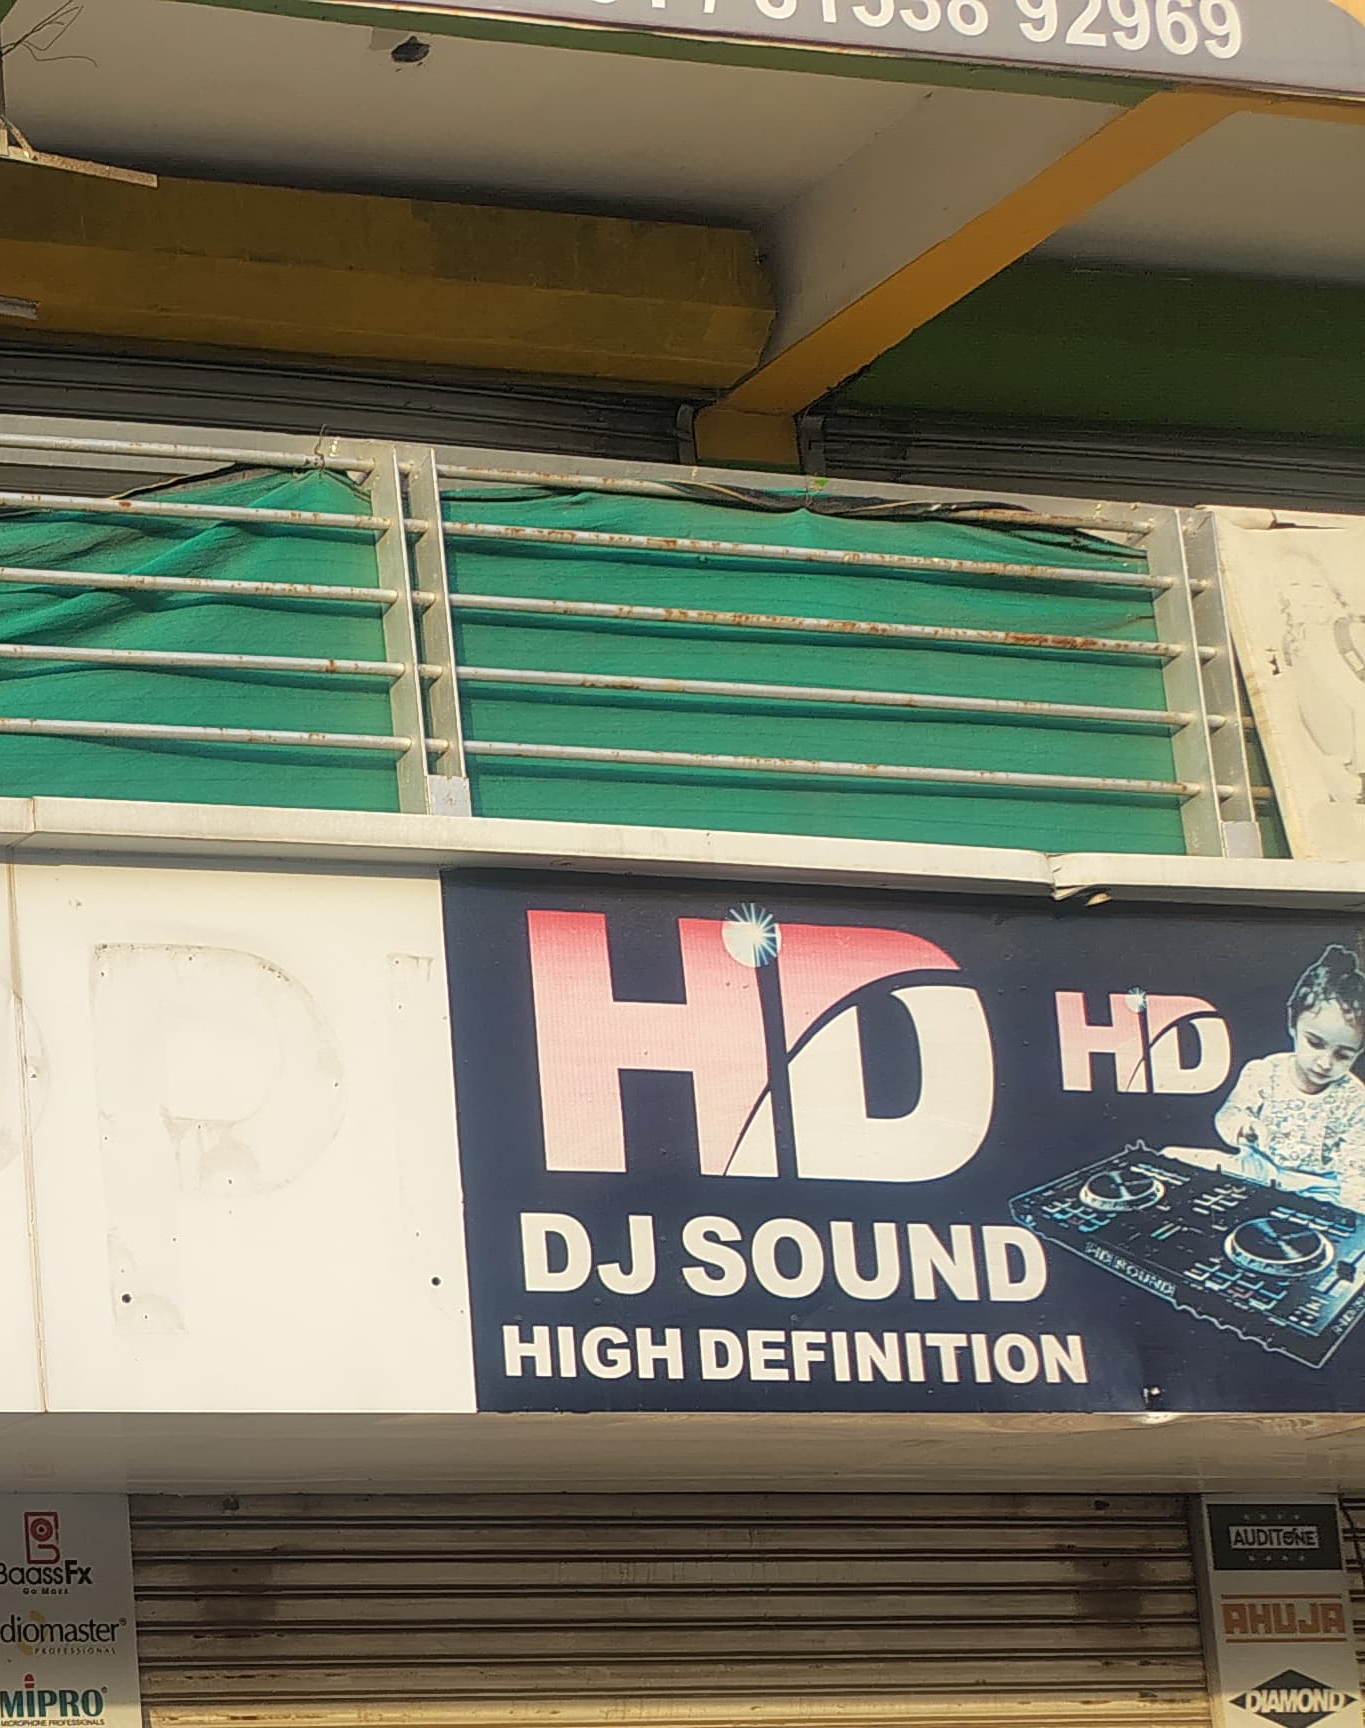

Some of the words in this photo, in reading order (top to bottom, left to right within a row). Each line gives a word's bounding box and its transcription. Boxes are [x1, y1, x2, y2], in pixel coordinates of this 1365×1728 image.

[527, 906, 996, 1184] HD
[1055, 987, 1232, 1094] HD
[520, 1211, 658, 1294] DJ
[681, 1216, 1048, 1303] SOUND
[502, 1325, 685, 1380] HIGH
[700, 1328, 1090, 1385] DEFINITION
[1223, 1603, 1346, 1633] AHUJA
[1247, 1689, 1344, 1712] DIAMOND
